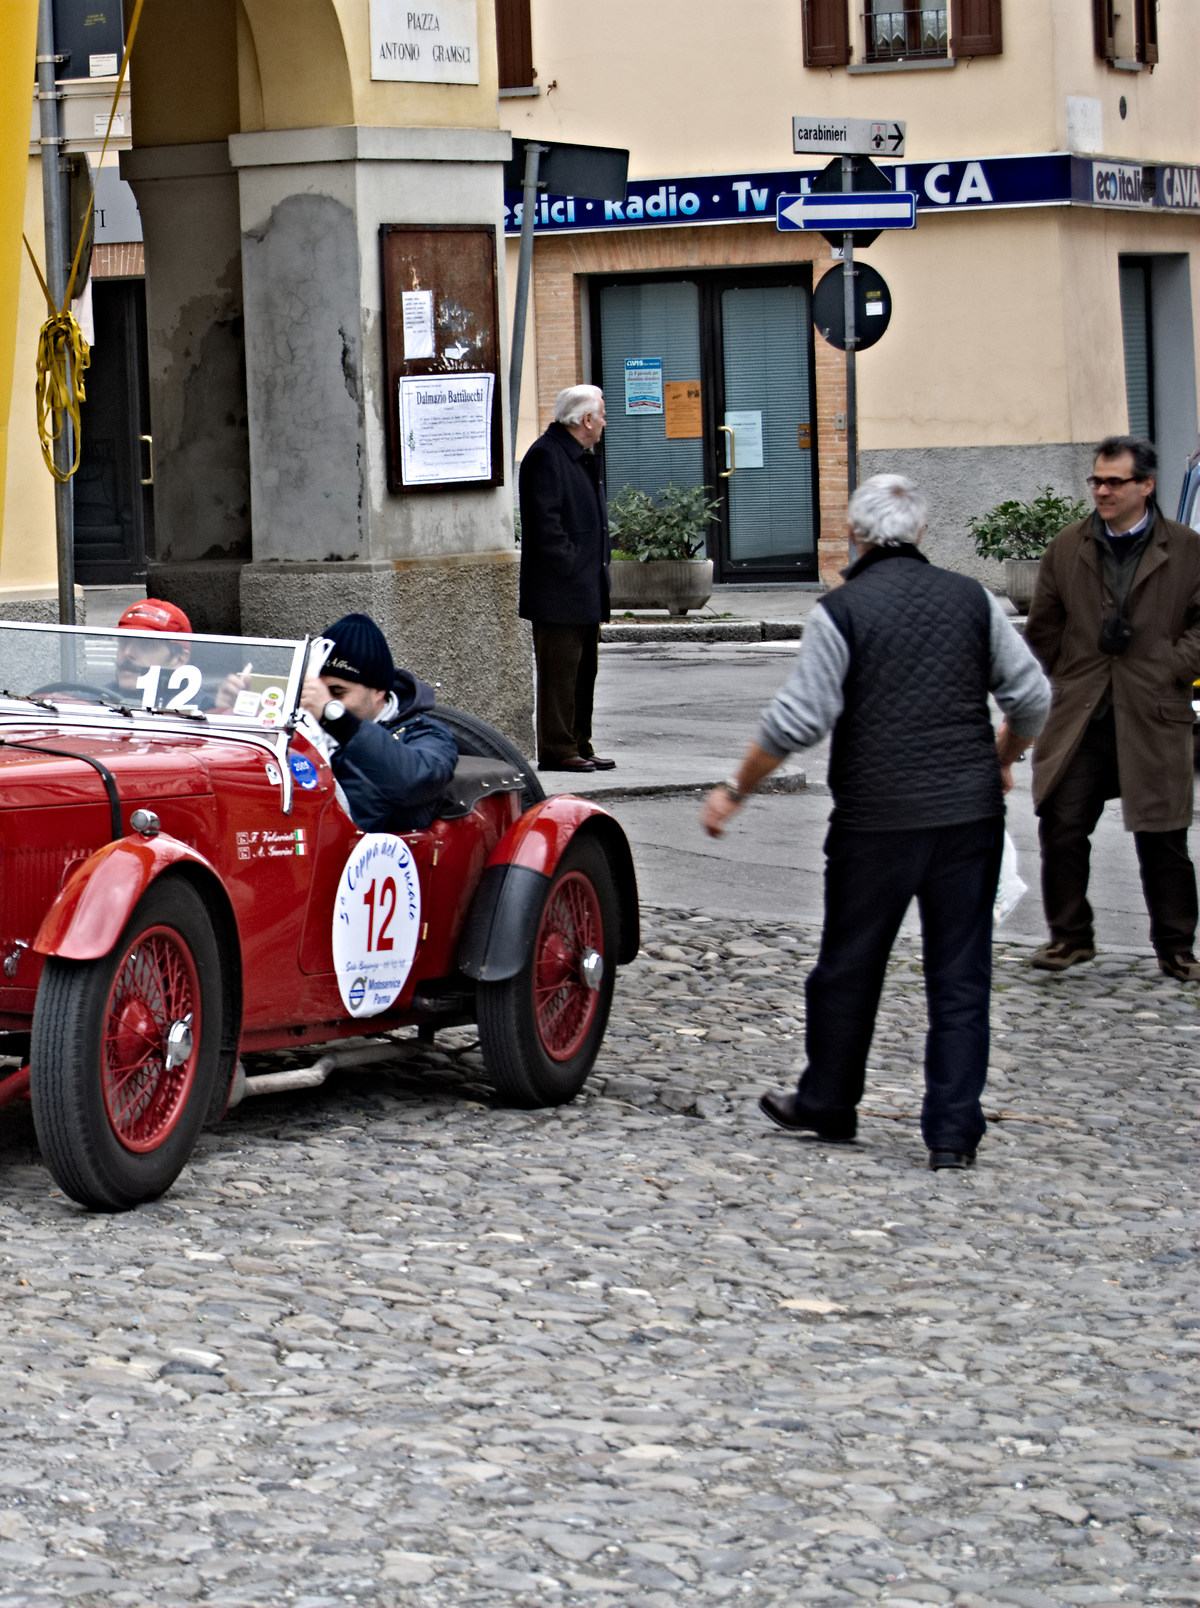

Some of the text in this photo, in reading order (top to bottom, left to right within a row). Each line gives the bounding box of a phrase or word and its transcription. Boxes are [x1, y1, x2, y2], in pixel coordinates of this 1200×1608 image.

[406, 12, 440, 31] PIAZZA
[379, 42, 471, 63] ANTONIO GRAMSCI
[798, 126, 847, 142] carabinieri
[604, 185, 700, 220] Radio
[732, 181, 769, 212] Tv
[1096, 168, 1153, 203] ecoitali
[416, 388, 484, 405] Dalmazio Battilocchi
[136, 664, 203, 710] 12
[347, 842, 379, 892] Coppa
[381, 837, 398, 858] del
[363, 875, 397, 953] 12
